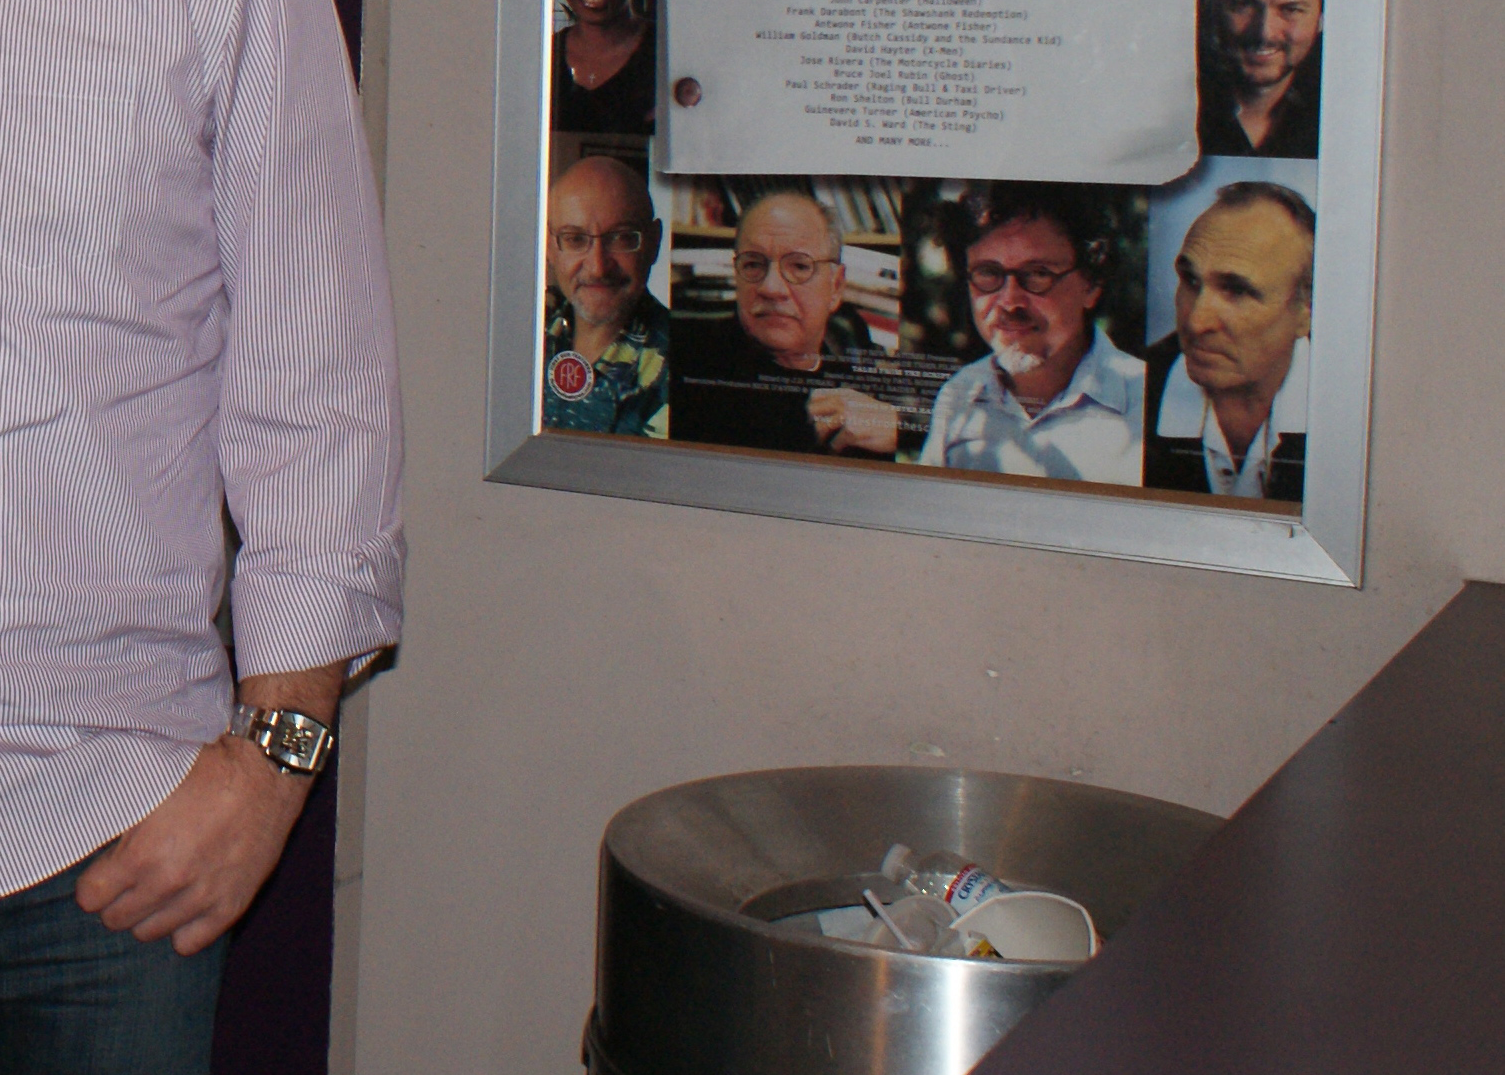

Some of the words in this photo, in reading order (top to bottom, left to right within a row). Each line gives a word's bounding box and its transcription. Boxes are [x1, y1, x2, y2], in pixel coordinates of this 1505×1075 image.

[786, 7, 815, 15] Frank
[820, 7, 866, 16] Darabont
[873, 8, 896, 18] (The
[901, 9, 955, 18] Shawshank
[961, 10, 1028, 20] Redemption)
[814, 20, 855, 29] Antwone
[861, 20, 896, 29] Fisher
[902, 21, 949, 31] (Antwone
[955, 22, 997, 32] Fisher)
[755, 31, 795, 40] William
[799, 32, 840, 40] Goldman
[846, 32, 881, 42] (Butch
[886, 33, 928, 44] Cassidy
[934, 34, 952, 43] and
[958, 35, 976, 44] the
[982, 35, 1032, 45] Sundance
[1037, 36, 1062, 46] Kid)
[845, 45, 875, 54] David
[880, 46, 916, 56] Hayter
[828, 57, 864, 66] Rivera
[869, 57, 892, 67] (The
[897, 58, 958, 69] Motorcycle
[963, 60, 1012, 71] Diaries)
[833, 69, 863, 78] Bruce
[869, 70, 891, 79] Joel
[898, 70, 928, 80] Rubin
[934, 71, 975, 82] (Ghost)
[785, 80, 808, 89] Paul
[813, 80, 859, 90] Schrader
[866, 82, 907, 94] (Raging
[912, 83, 936, 93] Bull
[955, 84, 978, 94] Taxi
[984, 84, 1027, 96] Driver)
[830, 93, 848, 102] Ron
[853, 94, 895, 103] Shelton
[901, 95, 930, 106] (Bull
[935, 96, 977, 107] Durham)
[862, 106, 897, 116] Turner
[904, 108, 957, 119] (American
[962, 110, 1005, 120] Psycho)
[829, 118, 859, 127] David
[864, 119, 876, 128] S.
[881, 120, 907, 129] Ward
[912, 121, 936, 131] (The
[941, 122, 976, 133] Sting)
[855, 135, 874, 145] AND
[878, 136, 903, 146] MANY
